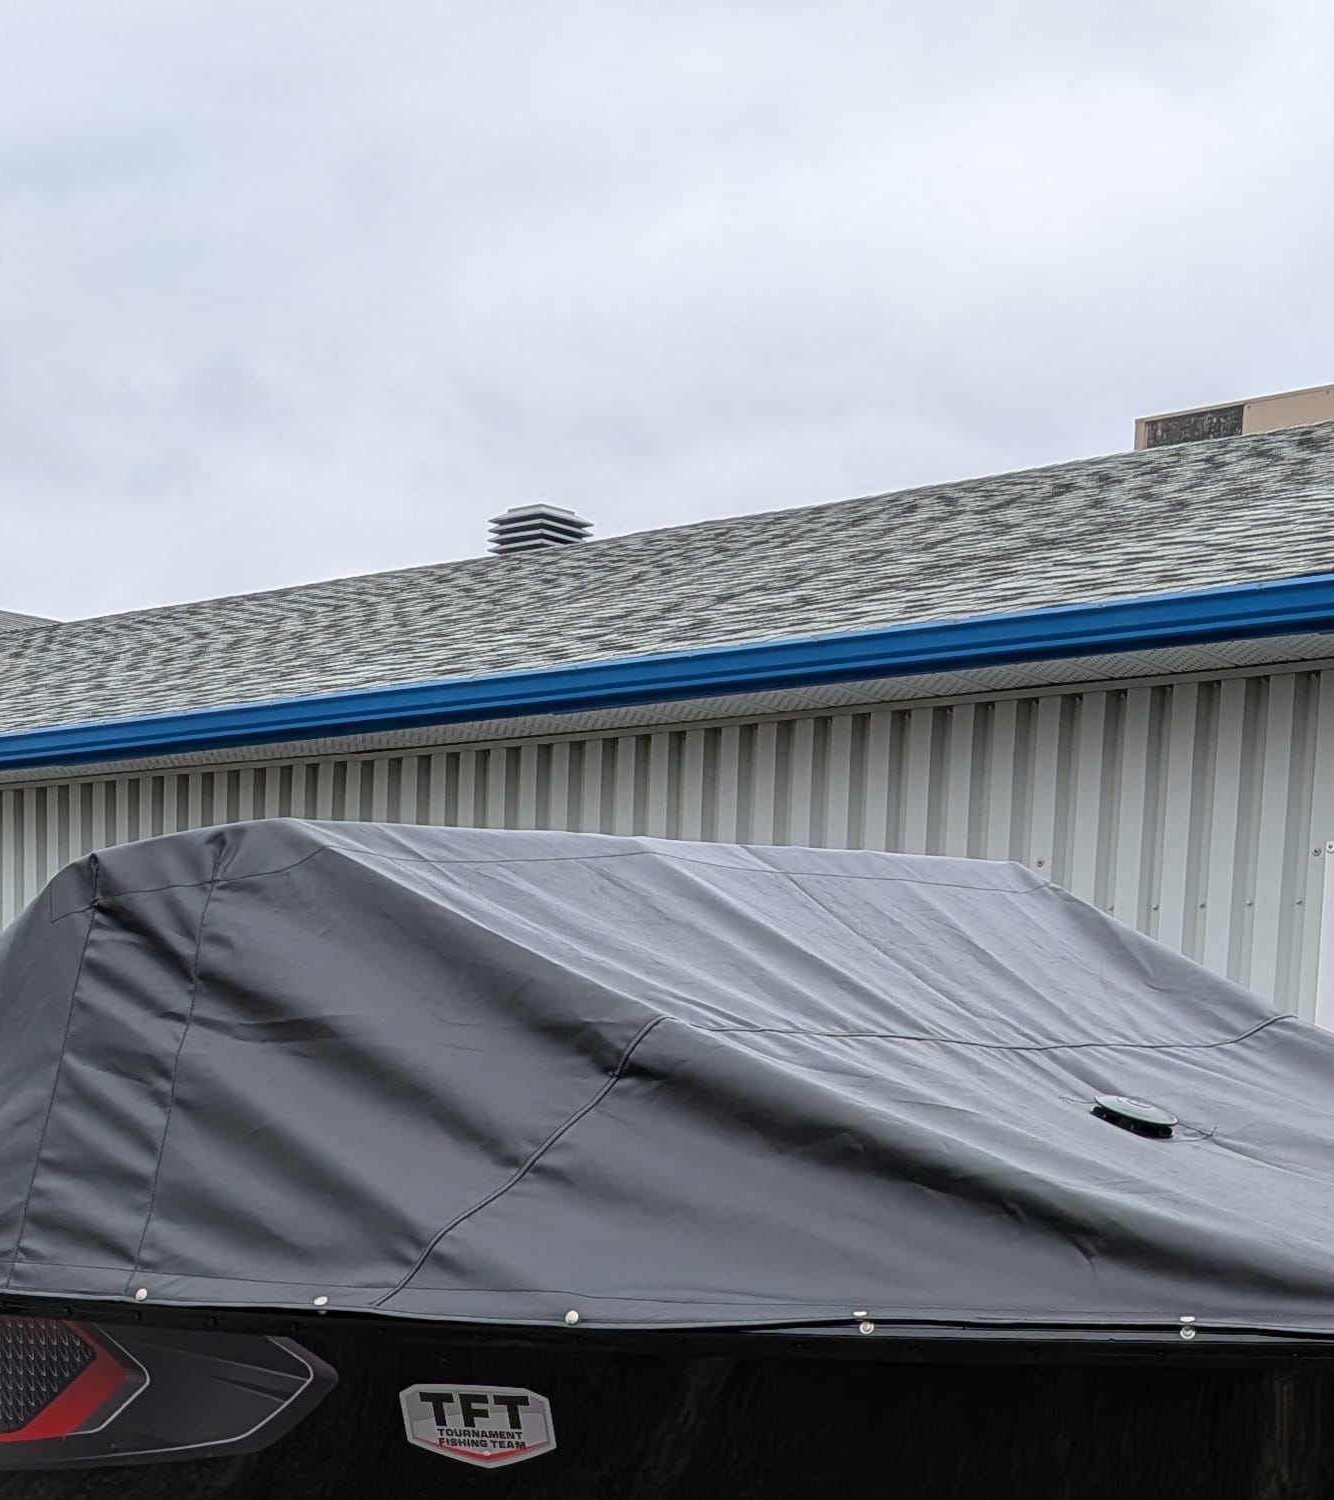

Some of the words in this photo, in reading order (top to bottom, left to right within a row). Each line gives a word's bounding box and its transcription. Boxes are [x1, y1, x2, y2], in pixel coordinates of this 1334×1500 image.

[418, 1391, 530, 1430] TFT
[437, 1427, 523, 1440] TOURNAMENT
[438, 1437, 489, 1448] FISHING
[490, 1440, 526, 1450] TEAM
